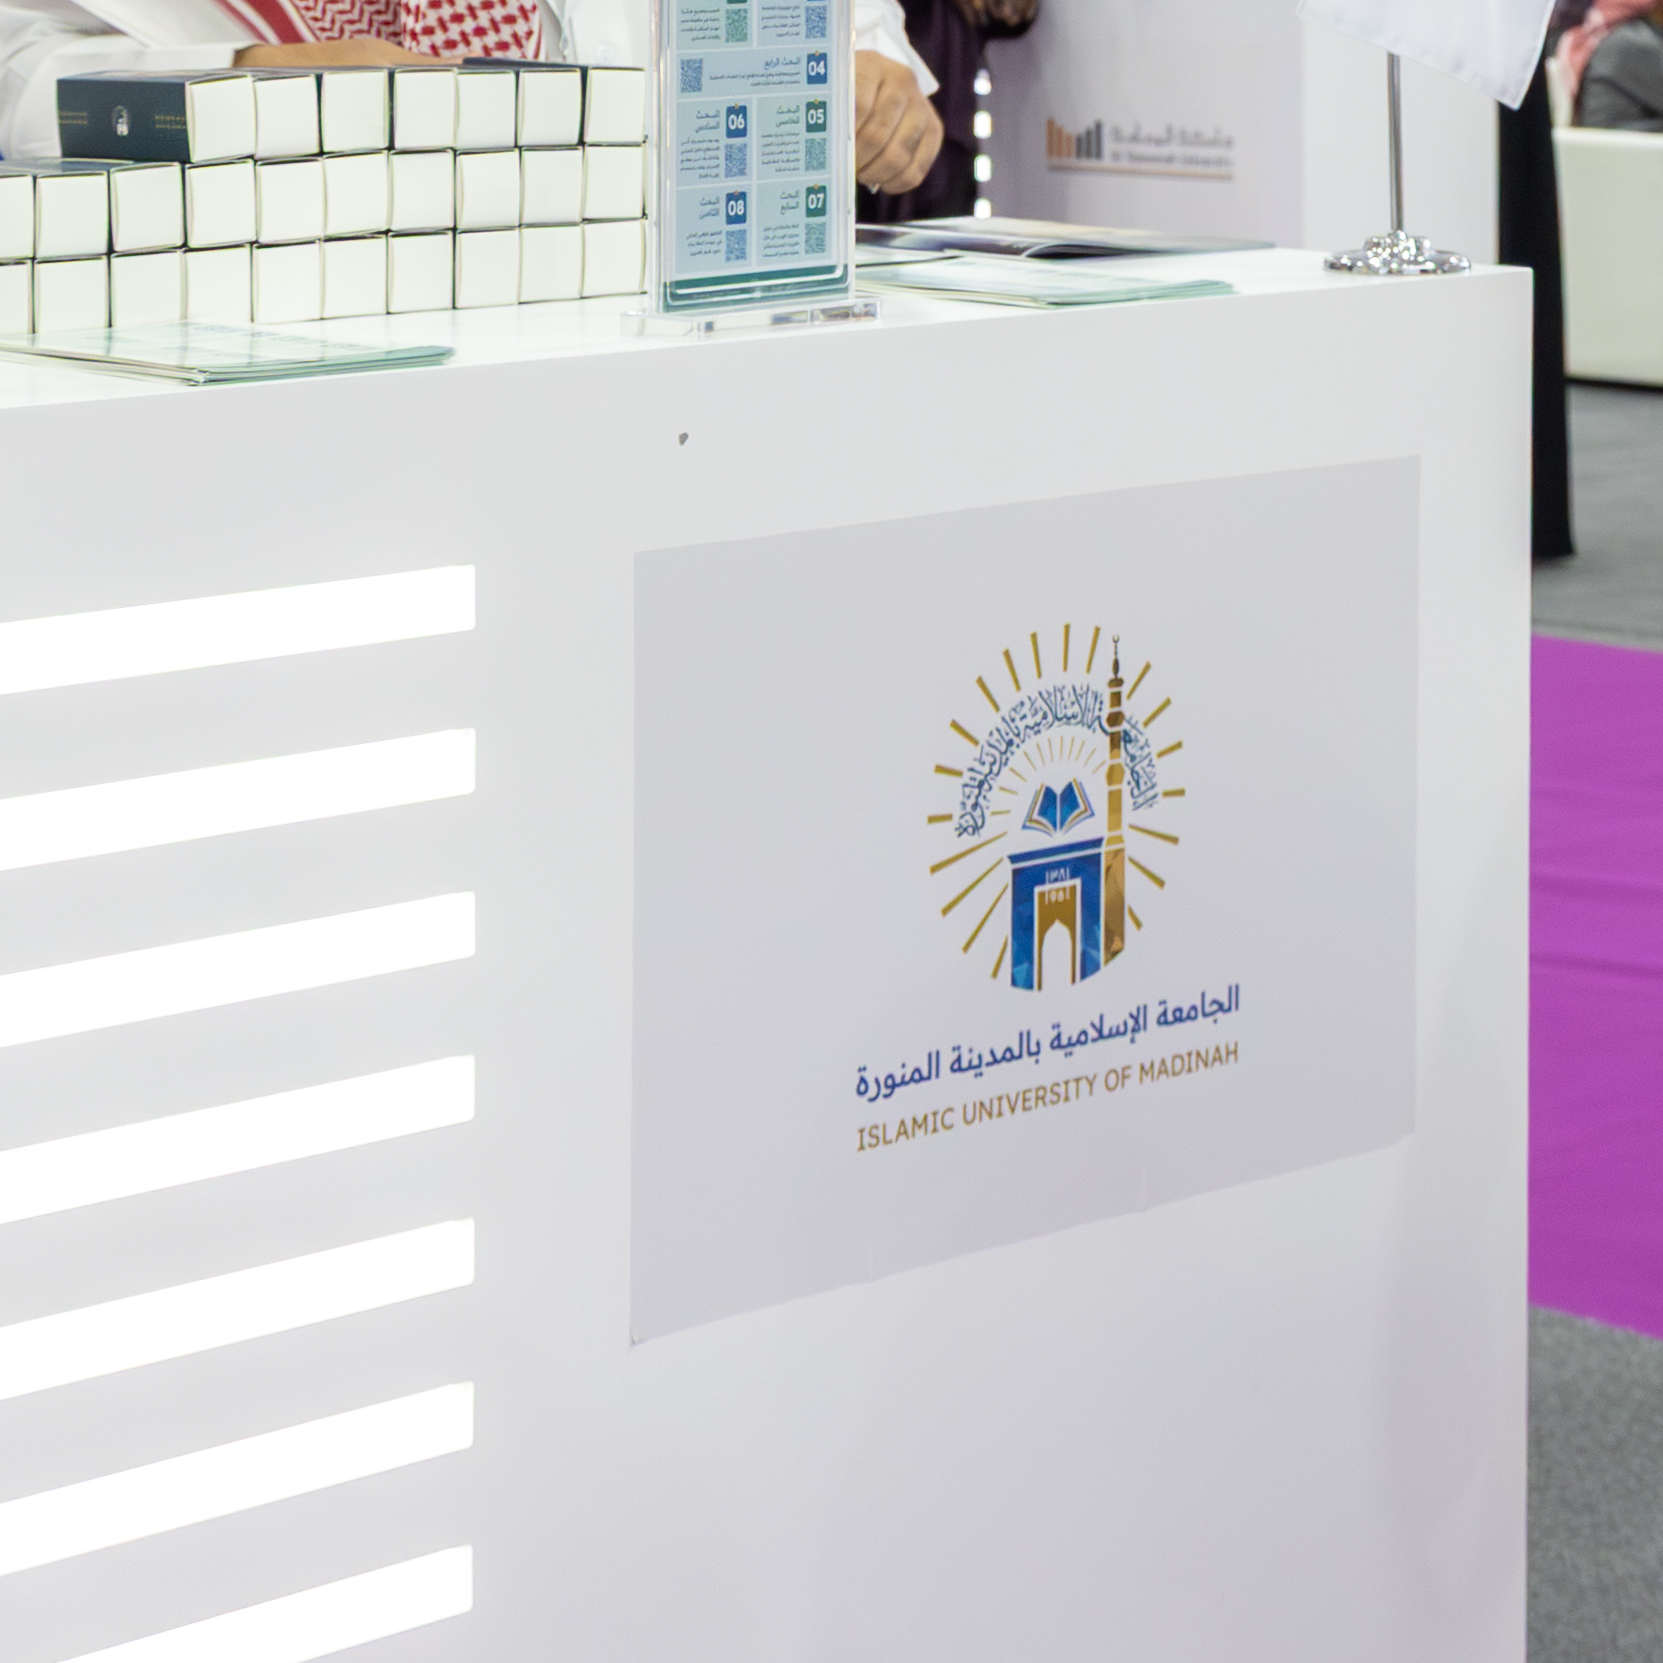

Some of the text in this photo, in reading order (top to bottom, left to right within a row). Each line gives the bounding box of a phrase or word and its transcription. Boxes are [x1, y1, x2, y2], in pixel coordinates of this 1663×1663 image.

[808, 60, 826, 76] 04
[728, 114, 745, 130] 06
[807, 109, 825, 124] 05
[727, 199, 745, 216] 08
[808, 193, 825, 209] 07
[855, 982, 1240, 1103] الجامعة الإسلامية بالمدينة المنورة
[856, 1041, 1239, 1153] ISLAMIC UNIVERSITY OF MADINAH
